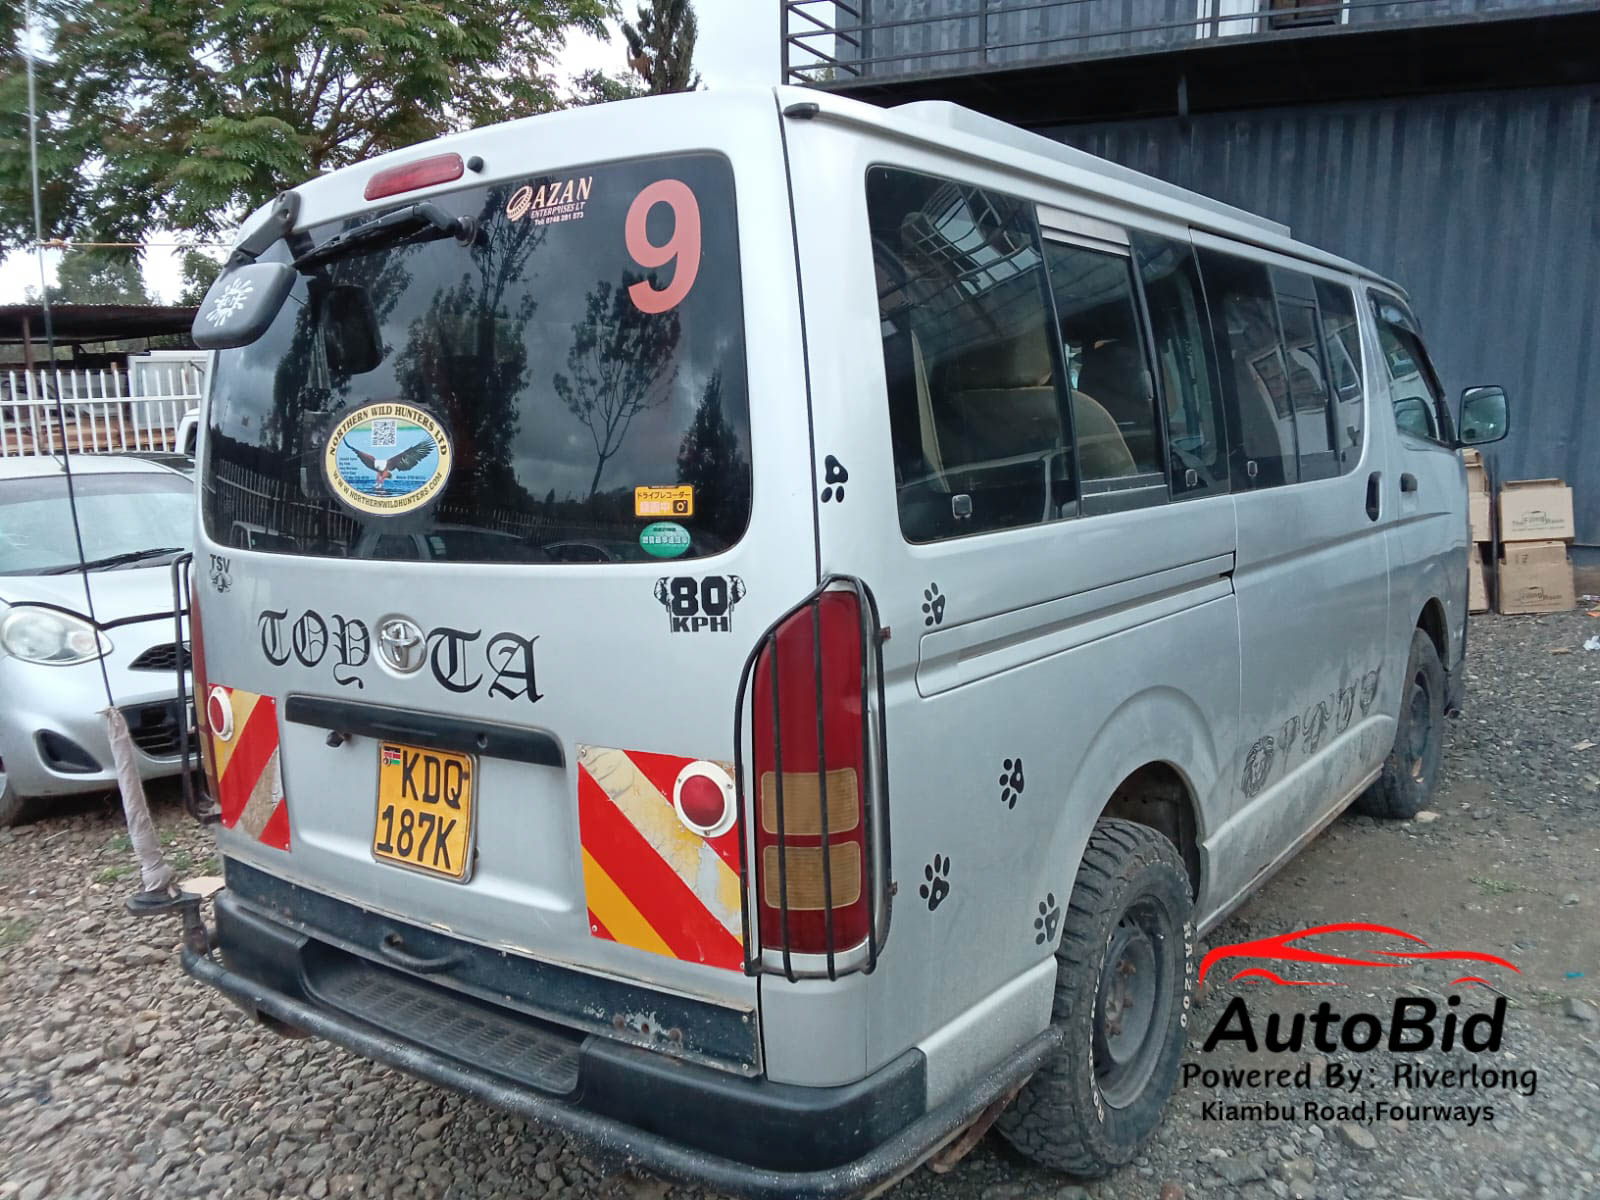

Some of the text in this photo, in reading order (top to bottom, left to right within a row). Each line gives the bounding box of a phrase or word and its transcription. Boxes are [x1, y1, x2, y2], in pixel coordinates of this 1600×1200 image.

[625, 179, 702, 314] 9
[330, 405, 448, 456] NORTHERN WILD HUNTERS LTD
[209, 553, 230, 574] TSV
[671, 576, 729, 616] 80
[672, 616, 728, 632] KPH
[402, 750, 464, 809] KDQ
[377, 805, 457, 869] 187K
